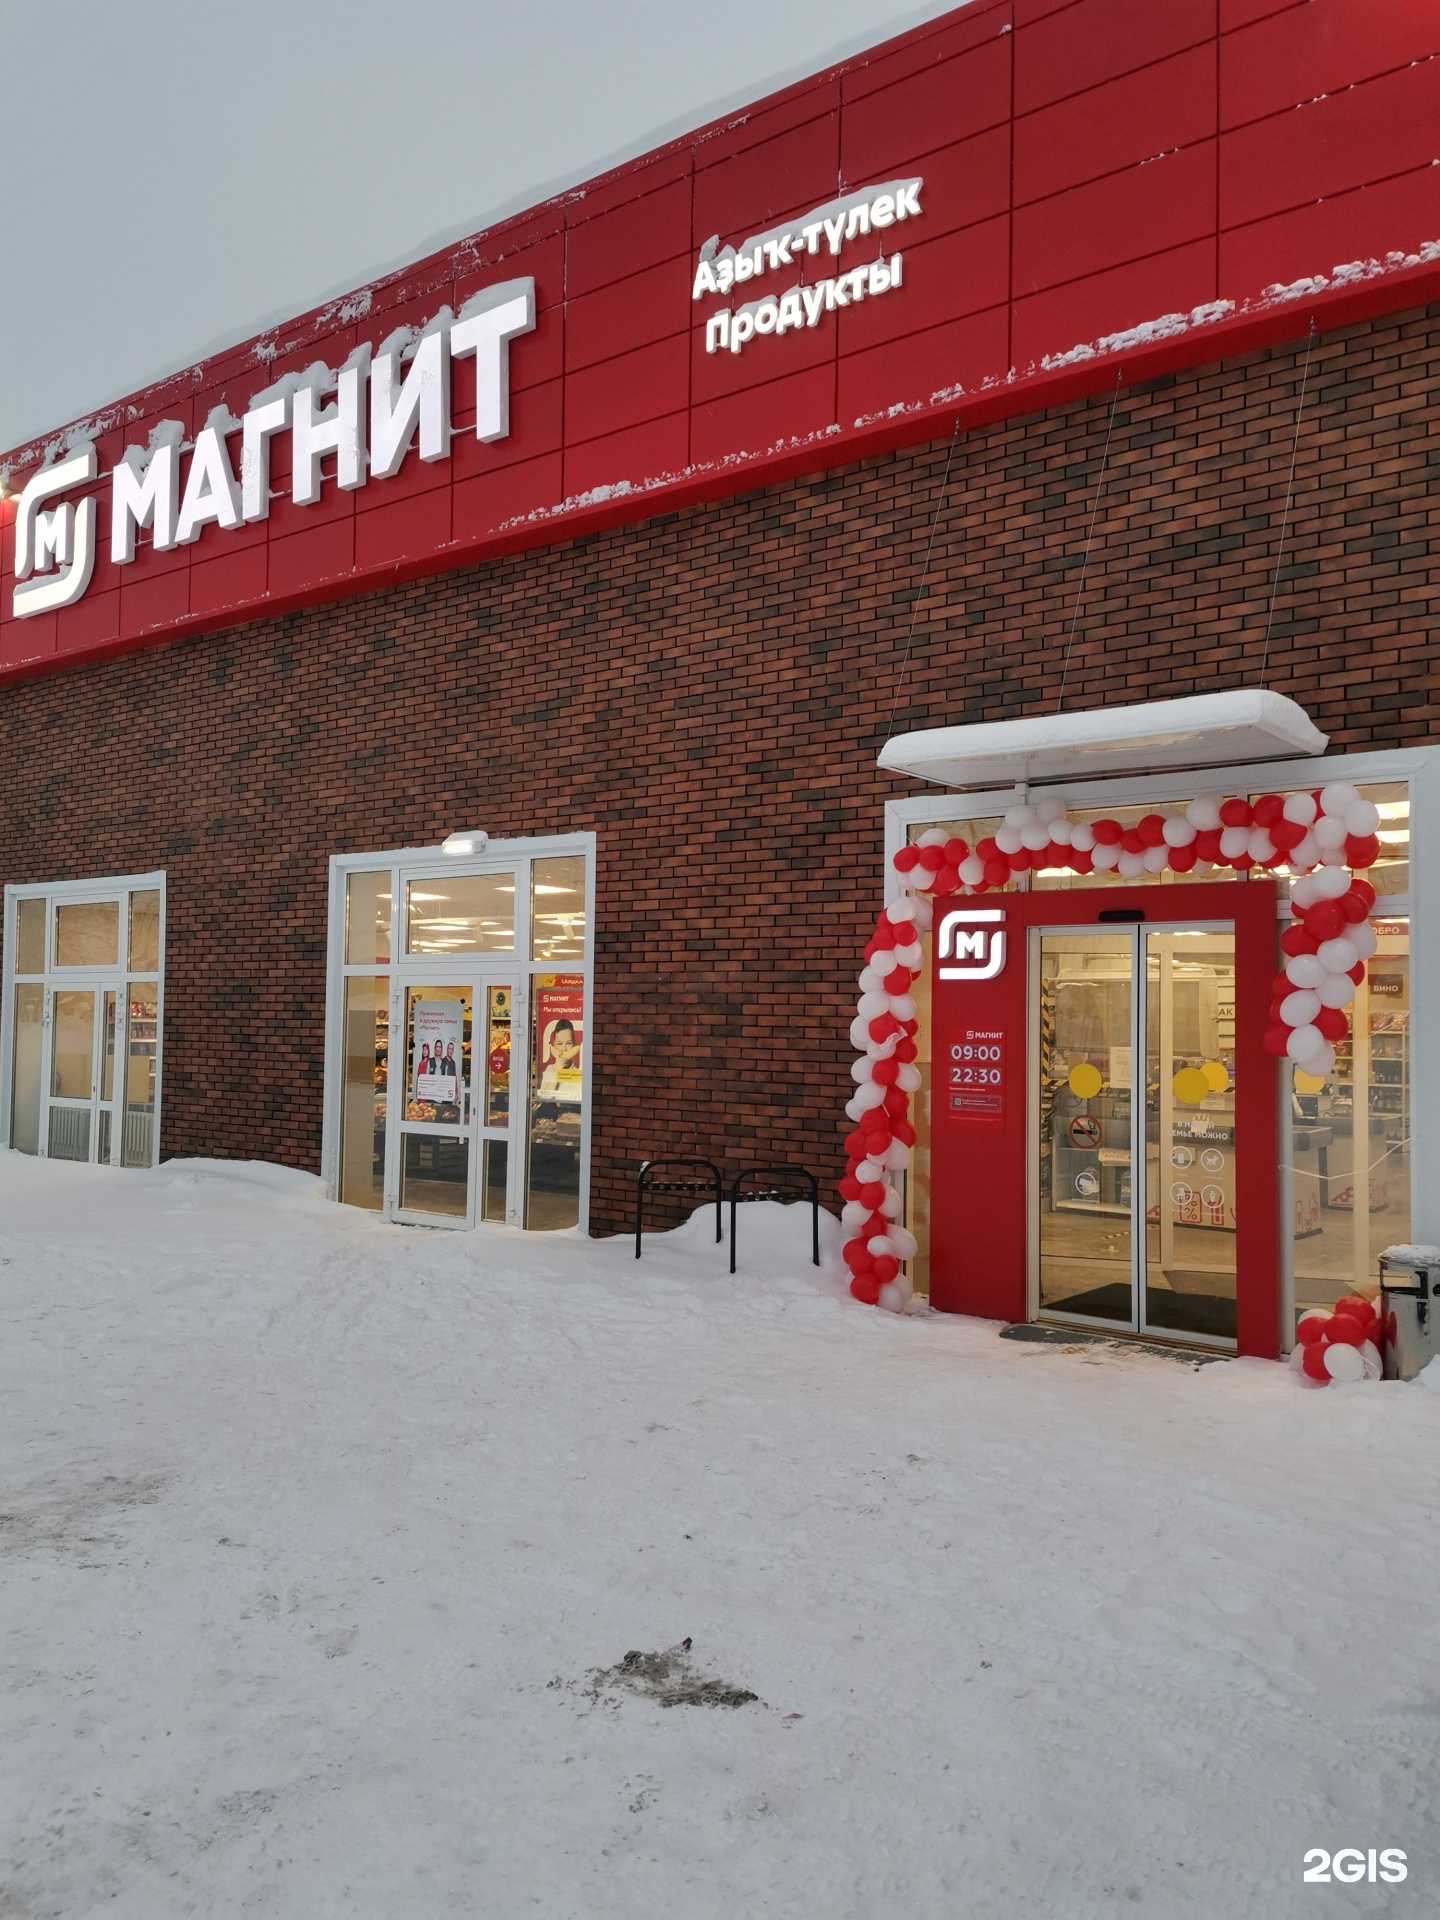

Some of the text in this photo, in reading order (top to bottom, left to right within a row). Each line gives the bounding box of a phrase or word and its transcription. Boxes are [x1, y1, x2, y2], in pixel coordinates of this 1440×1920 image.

[706, 252, 903, 353] Продукты
[111, 293, 536, 565] МАГНИТ
[974, 1031, 1003, 1039] МАГНИТ
[951, 1045, 1001, 1061] 09:00
[952, 1068, 1001, 1084] 22:30
[1194, 1131, 1228, 1140] МОЖНО
